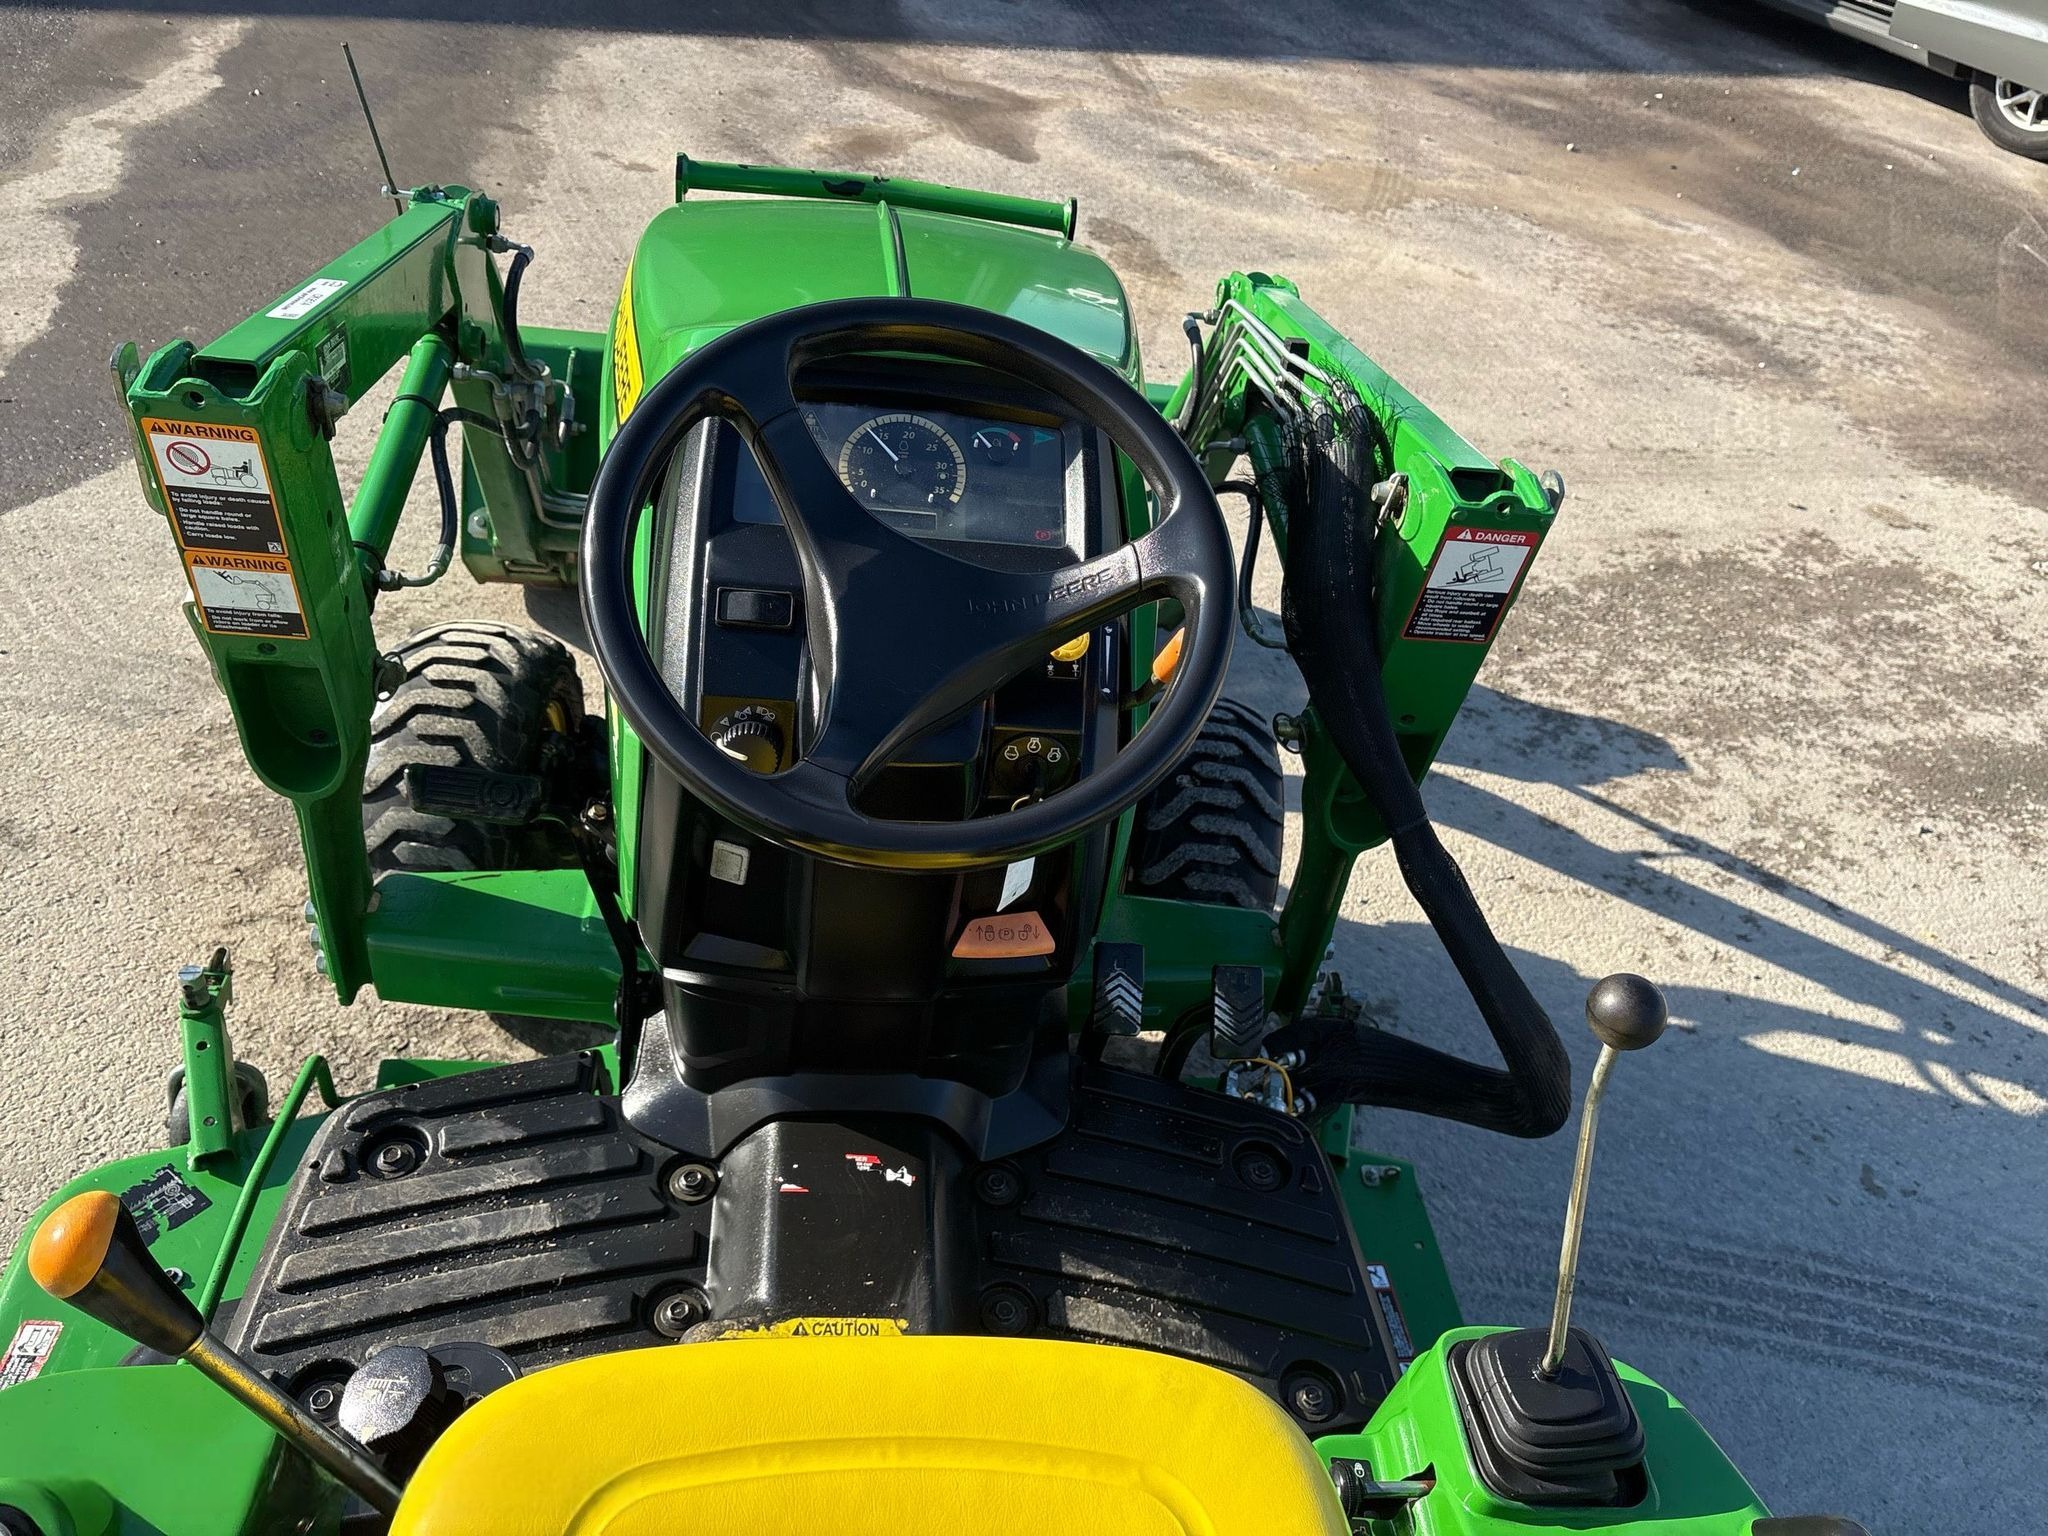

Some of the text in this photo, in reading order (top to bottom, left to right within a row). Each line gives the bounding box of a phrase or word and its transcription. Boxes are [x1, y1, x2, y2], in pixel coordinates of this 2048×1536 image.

[166, 422, 254, 441] WARNING
[862, 446, 873, 454] 10
[1475, 532, 1526, 543] DANGER
[206, 556, 287, 571] WARNING
[1034, 567, 1114, 604] DEERE
[812, 1323, 879, 1336] CAUTION
